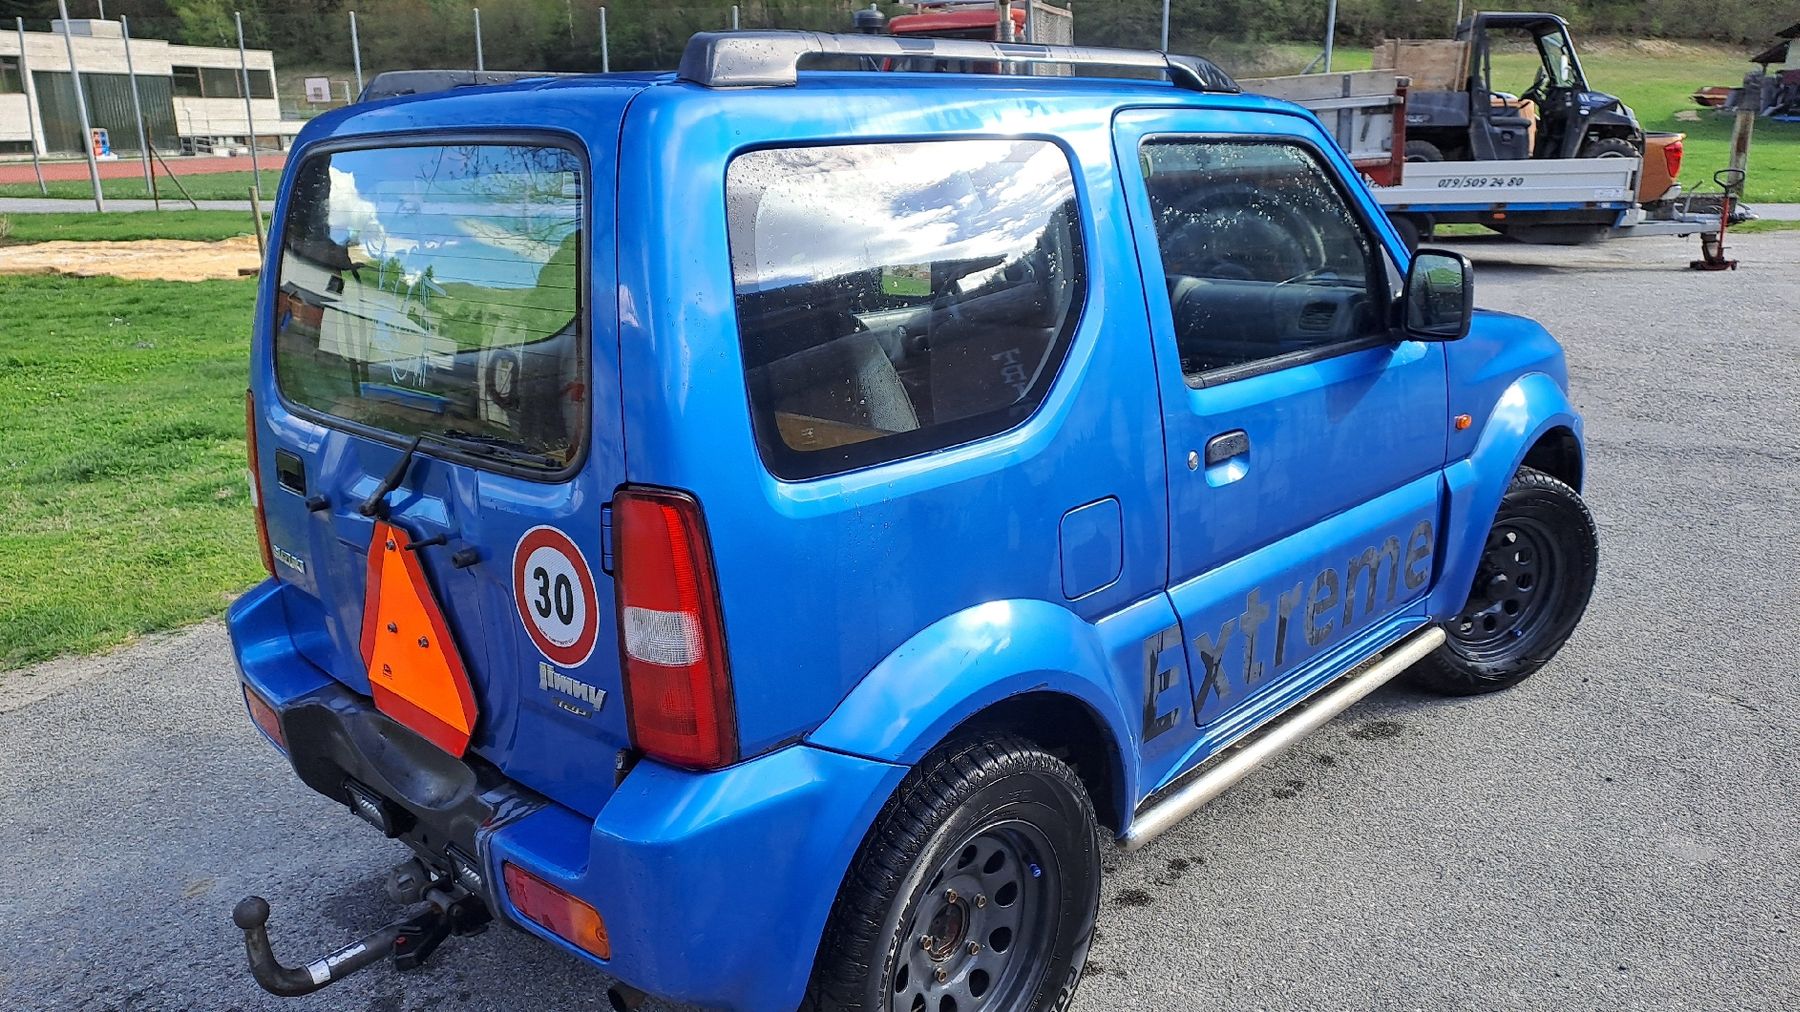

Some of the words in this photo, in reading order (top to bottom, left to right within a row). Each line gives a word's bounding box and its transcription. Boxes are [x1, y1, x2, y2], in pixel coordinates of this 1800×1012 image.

[1437, 176, 1487, 188] 079/509
[1489, 177, 1505, 187] 24
[1507, 177, 1524, 187] 80
[533, 566, 574, 625] 30
[1143, 519, 1434, 744] Extreme
